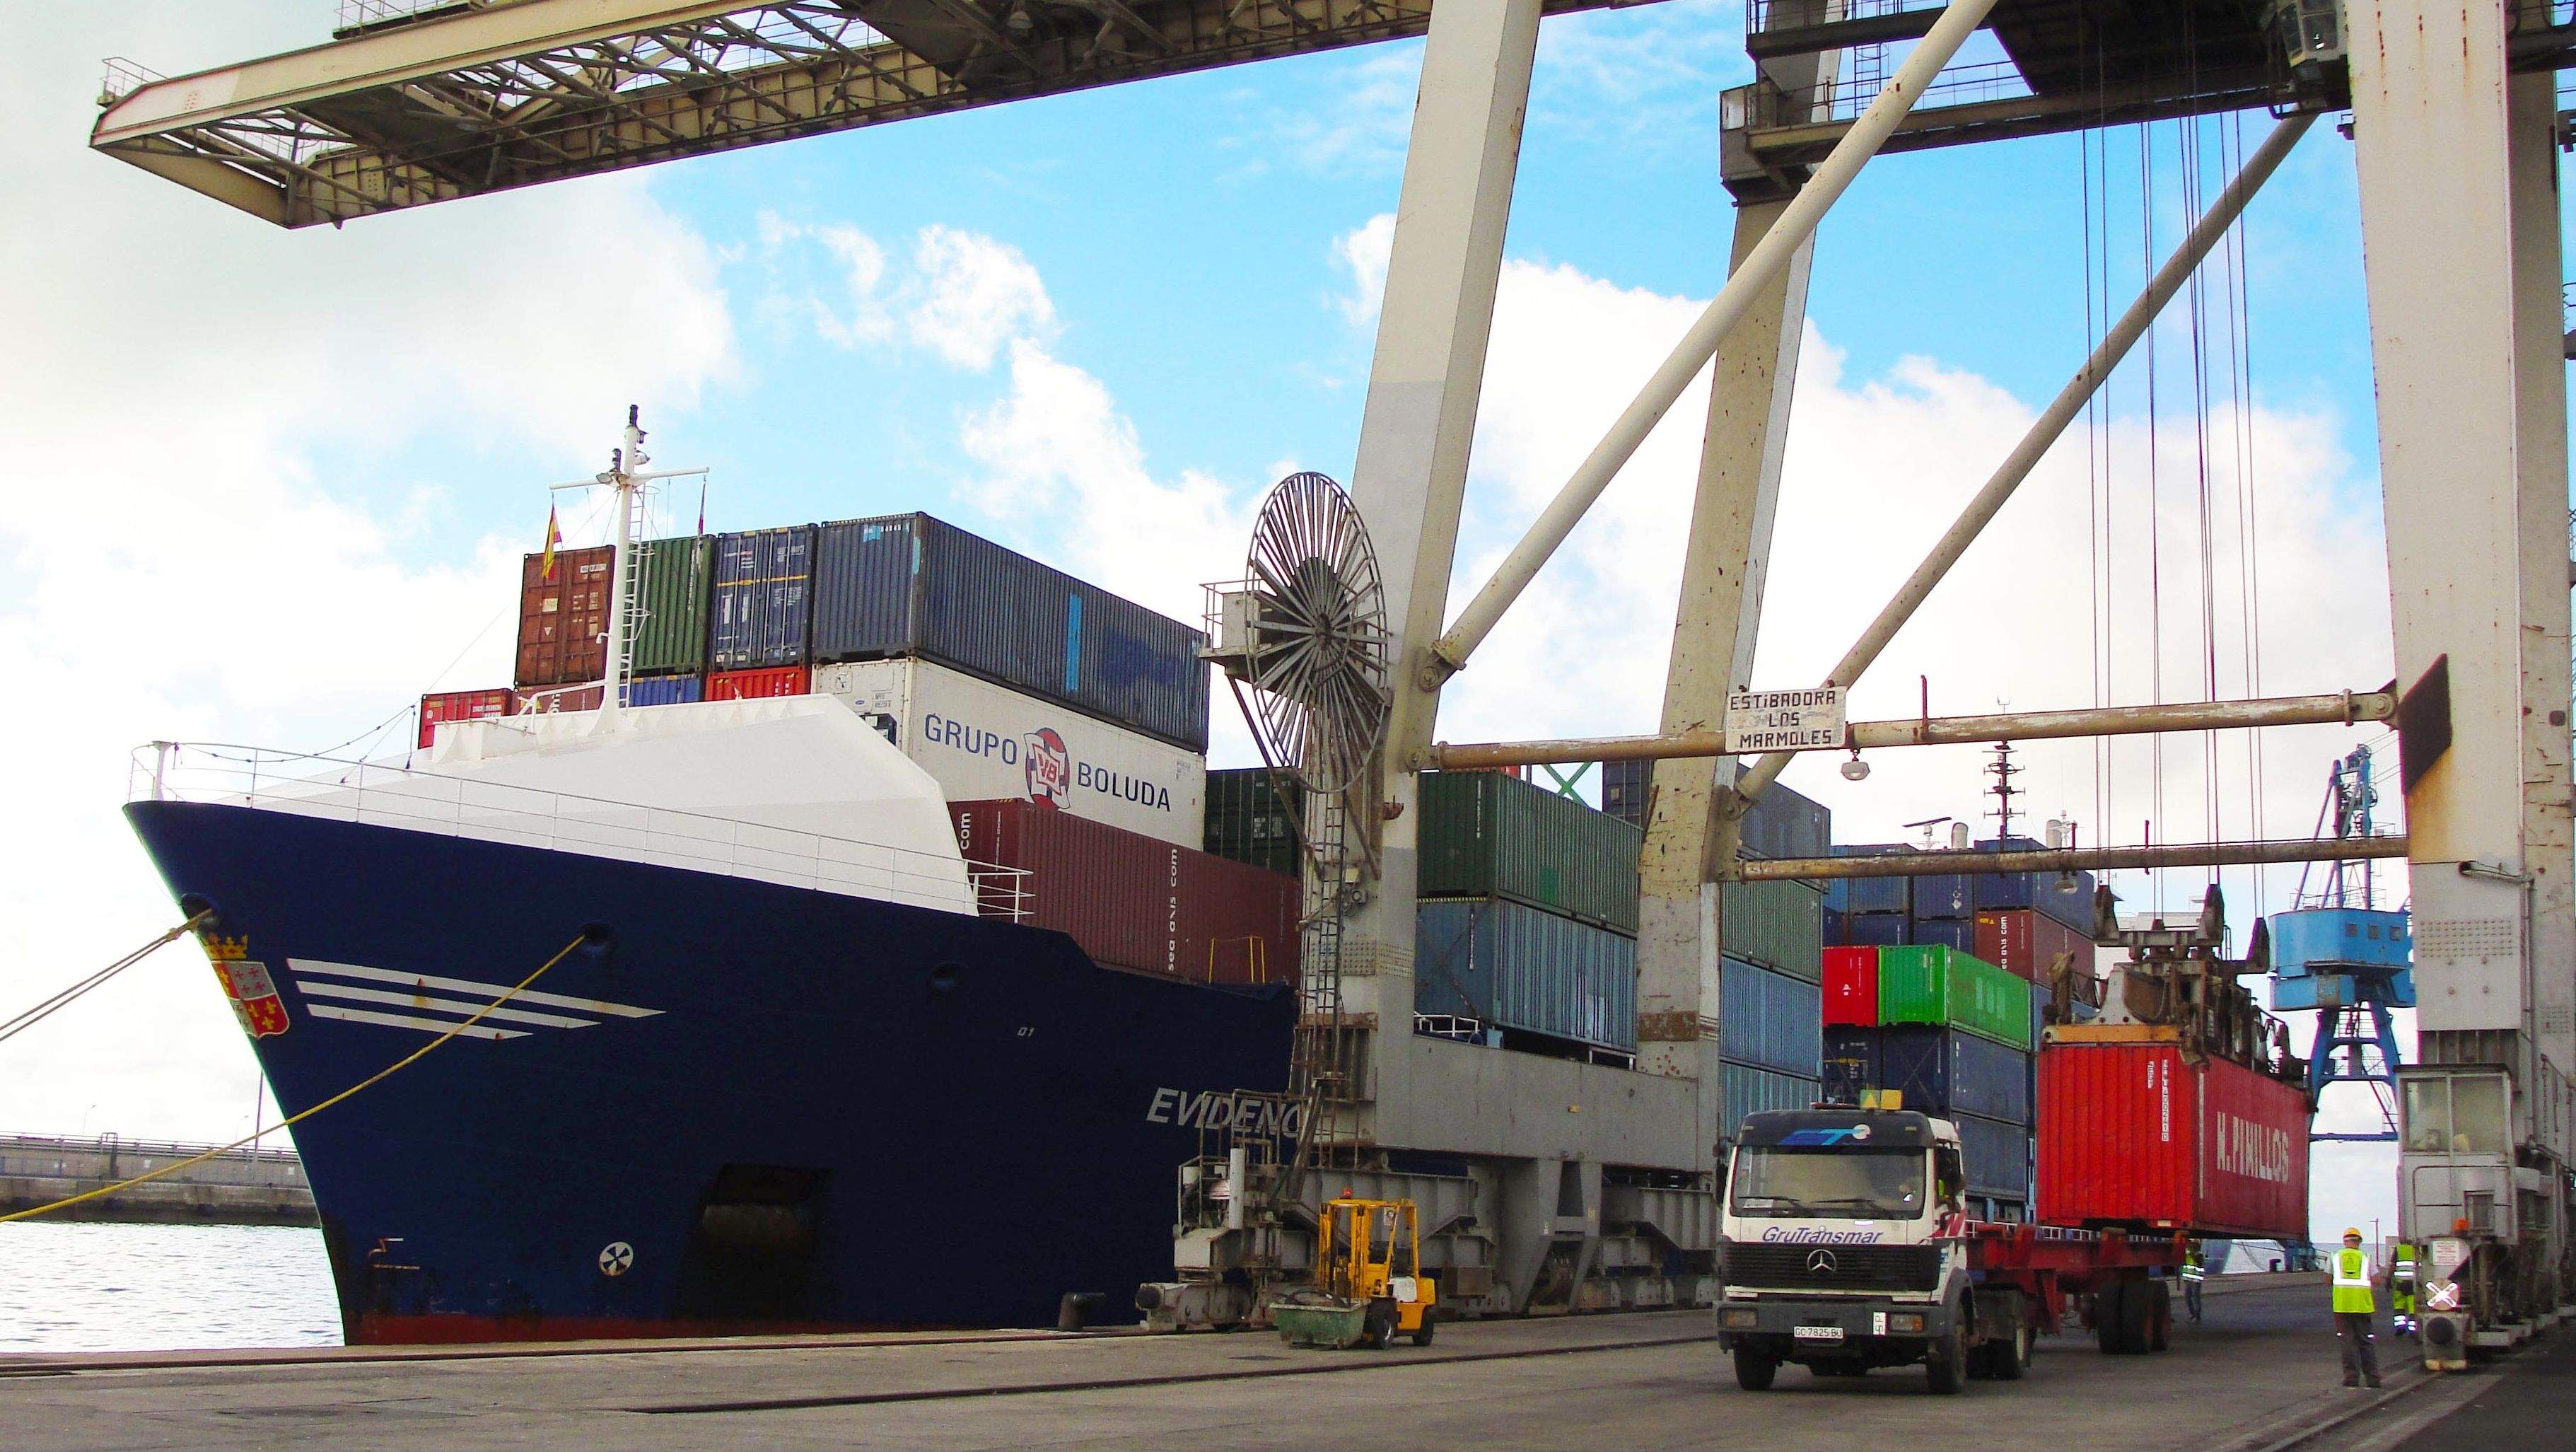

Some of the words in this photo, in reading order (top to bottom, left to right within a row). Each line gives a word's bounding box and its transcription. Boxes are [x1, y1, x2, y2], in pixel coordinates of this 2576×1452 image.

[1739, 729, 1832, 748] MARMOLES
[1768, 712, 1800, 728] LOS
[925, 713, 1018, 765] GRUPO
[1078, 762, 1171, 813] BOLUDA
[960, 813, 971, 850] com
[1146, 1087, 1300, 1138] EVIDENC
[1762, 1226, 1884, 1244] GruTransmar
